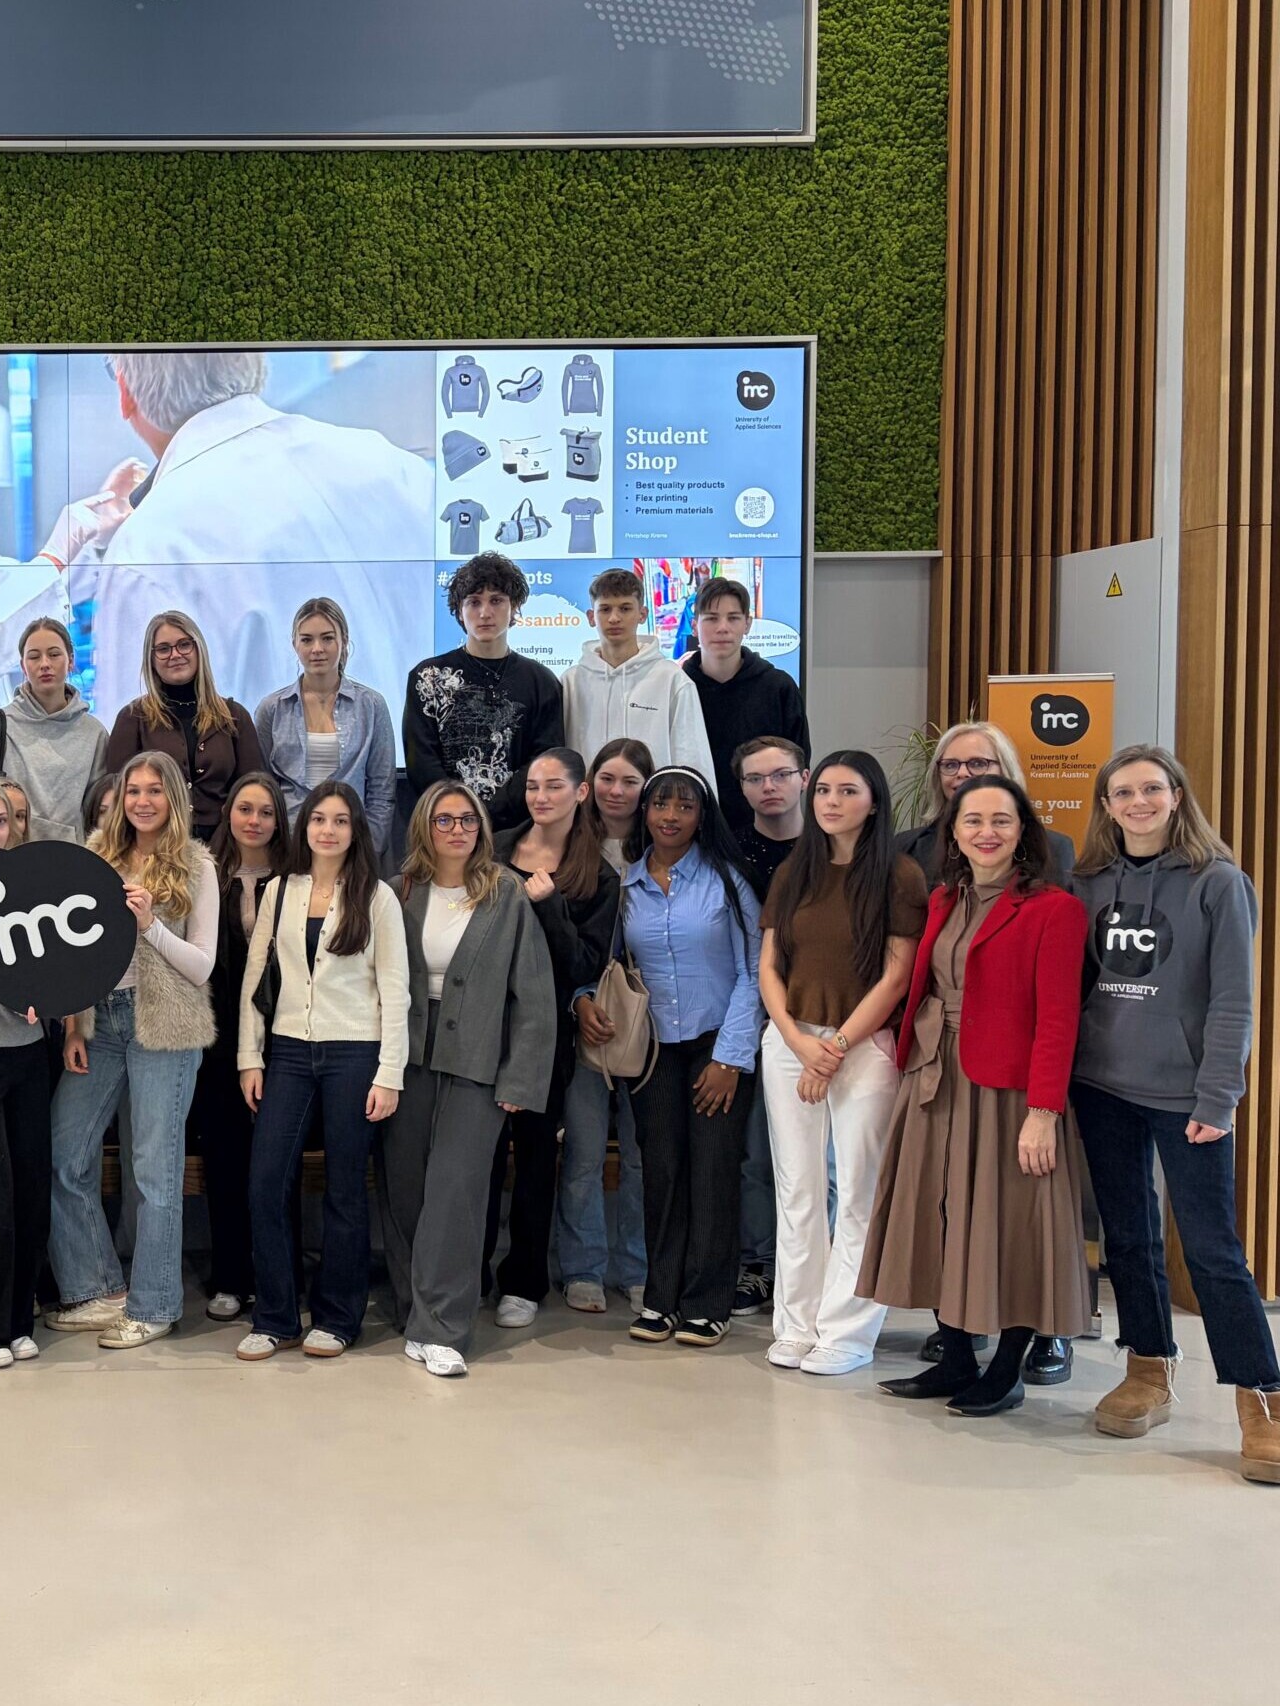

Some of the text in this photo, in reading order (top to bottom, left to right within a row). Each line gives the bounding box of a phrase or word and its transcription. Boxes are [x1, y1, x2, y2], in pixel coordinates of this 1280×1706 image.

[742, 376, 769, 398] imc
[625, 426, 709, 445] Student
[625, 452, 677, 474] Shop
[635, 481, 725, 490] Best quality products
[635, 494, 688, 503] Flex printing
[635, 506, 714, 515] Premium materials
[516, 613, 581, 627] ssandro
[516, 645, 553, 655] studying
[536, 658, 573, 667] hemistry
[1040, 701, 1079, 729] imc
[1030, 753, 1079, 761] University of
[1030, 762, 1097, 771] Applied Sciences
[1061, 771, 1089, 779] Austria
[1046, 799, 1083, 812] your
[1106, 911, 1156, 952] imc
[1098, 982, 1160, 996] UNIVERSITY
